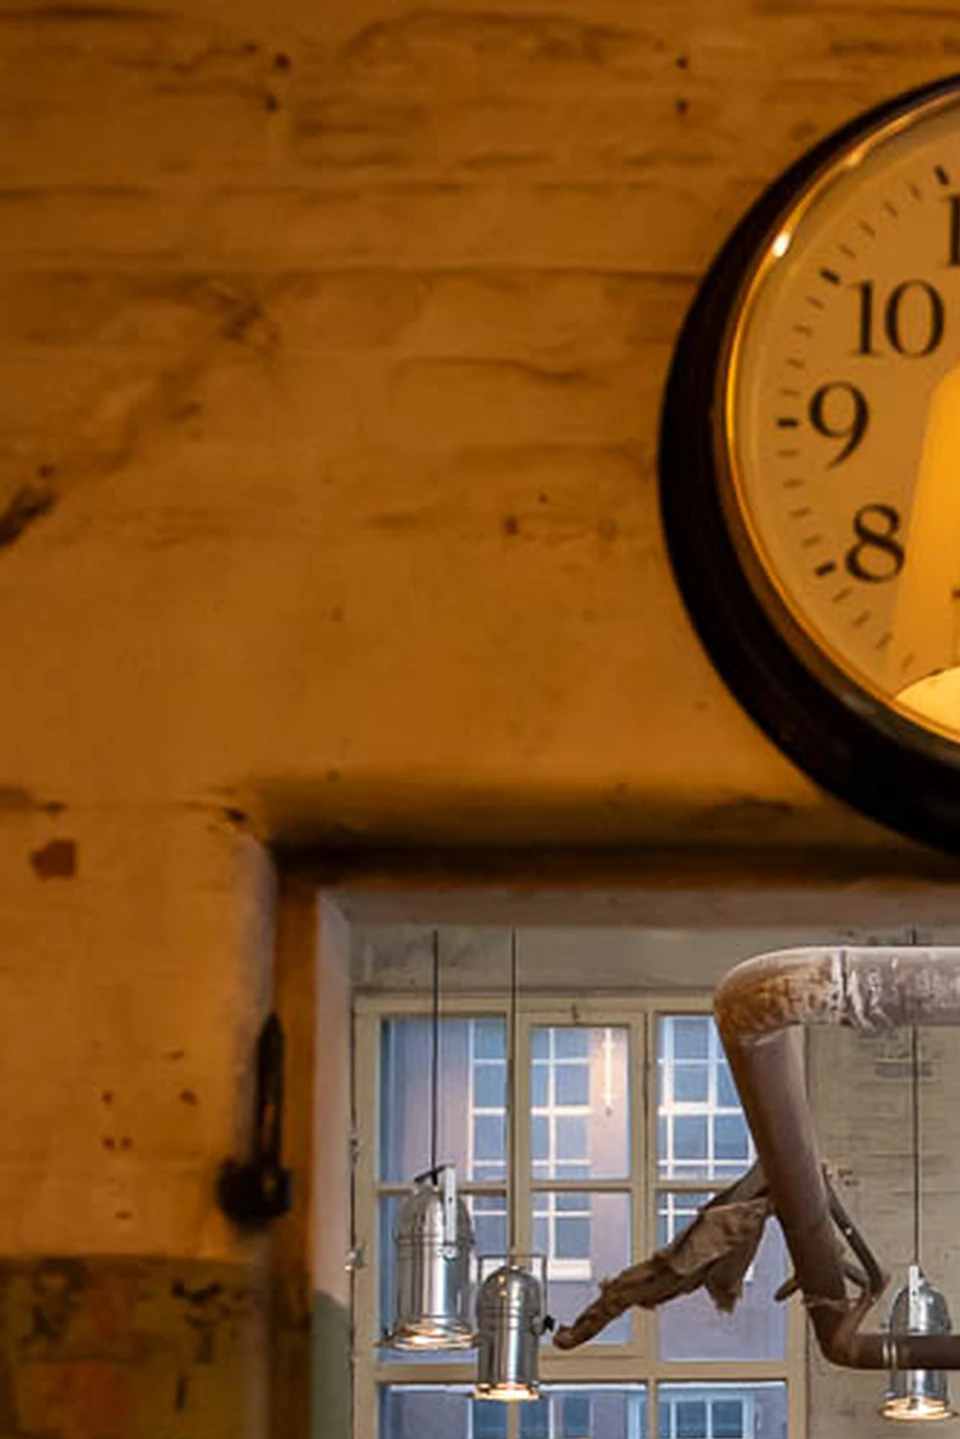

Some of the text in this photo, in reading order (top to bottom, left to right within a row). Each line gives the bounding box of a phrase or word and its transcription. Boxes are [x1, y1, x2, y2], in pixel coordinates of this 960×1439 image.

[852, 278, 945, 359] 10
[808, 381, 869, 468] 9
[845, 504, 905, 584] 8
